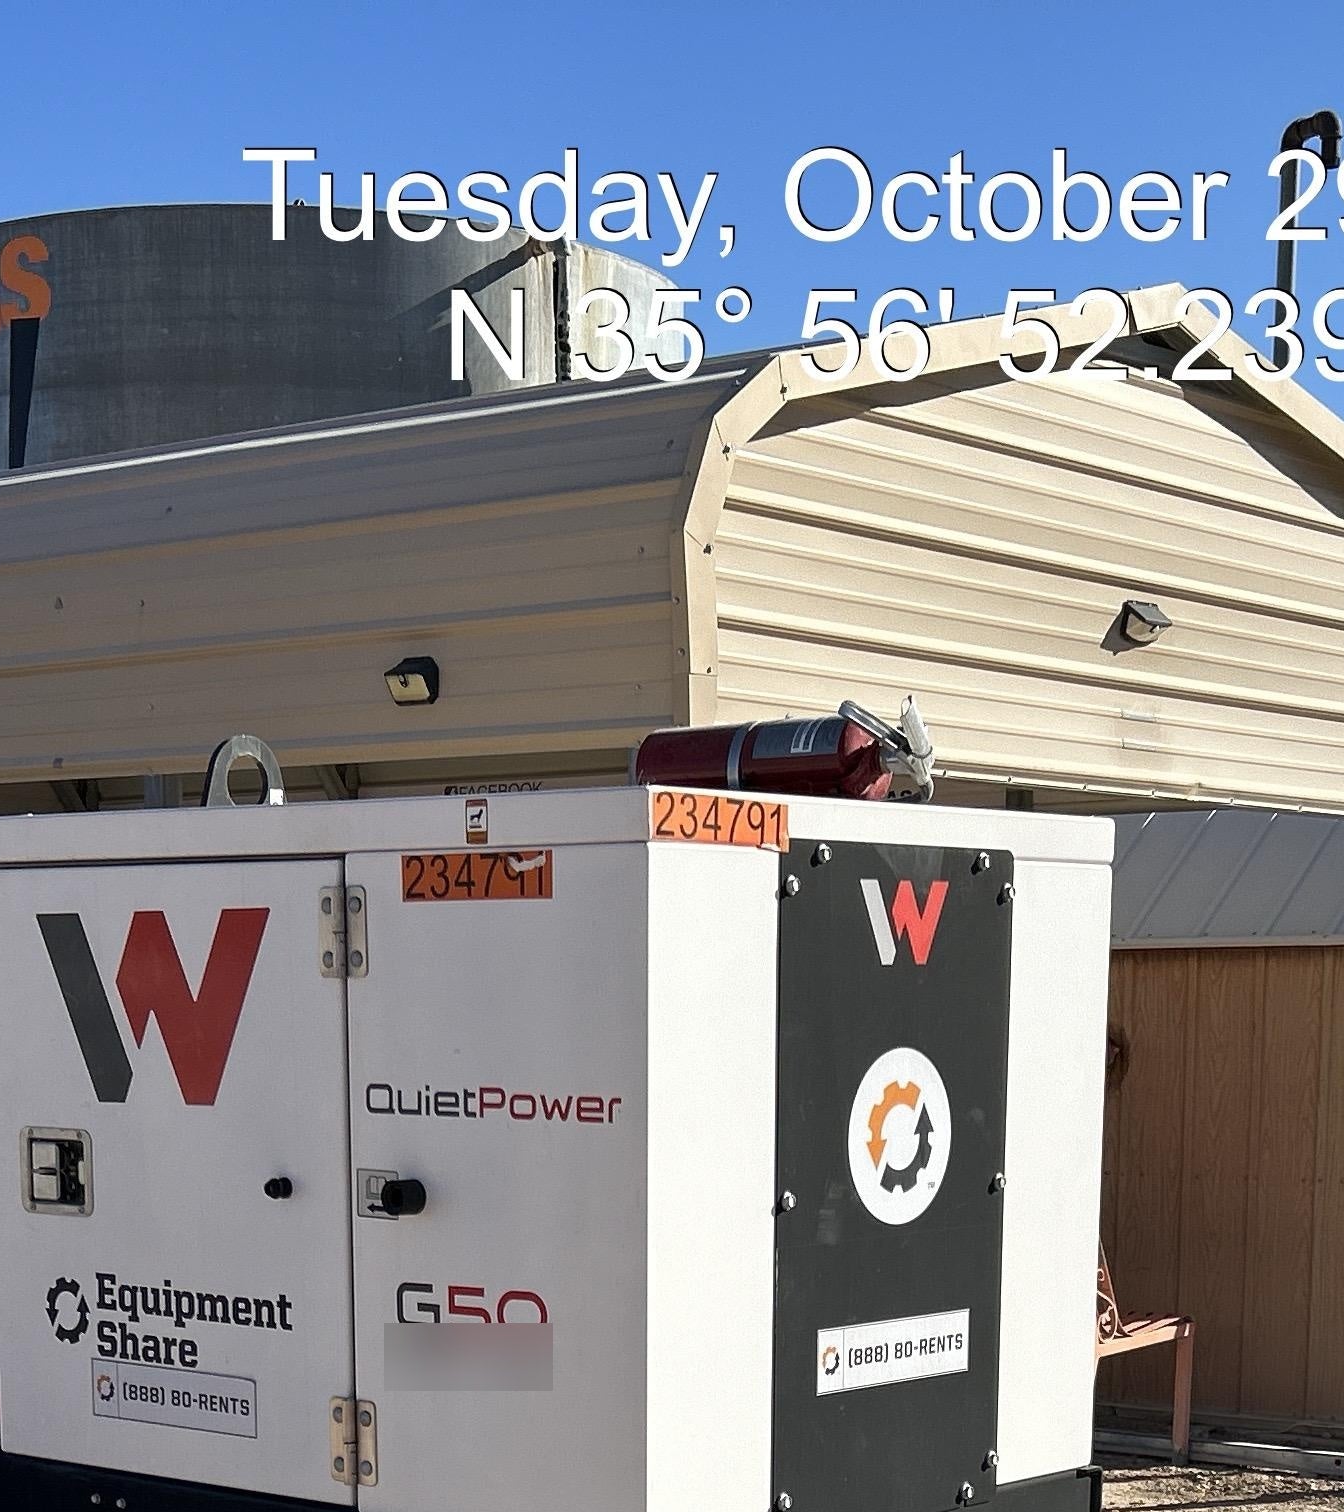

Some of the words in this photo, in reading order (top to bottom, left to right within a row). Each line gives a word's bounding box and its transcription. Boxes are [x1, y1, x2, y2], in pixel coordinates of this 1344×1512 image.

[655, 791, 785, 845] 234791
[365, 1083, 622, 1124] QuietPower
[95, 1272, 293, 1331] Equipment
[97, 1320, 199, 1368] Share
[848, 1343, 889, 1368] (888)
[894, 1333, 963, 1360] 80-RENTS
[122, 1381, 166, 1407] (888)
[171, 1391, 250, 1416] 80-RENTS
